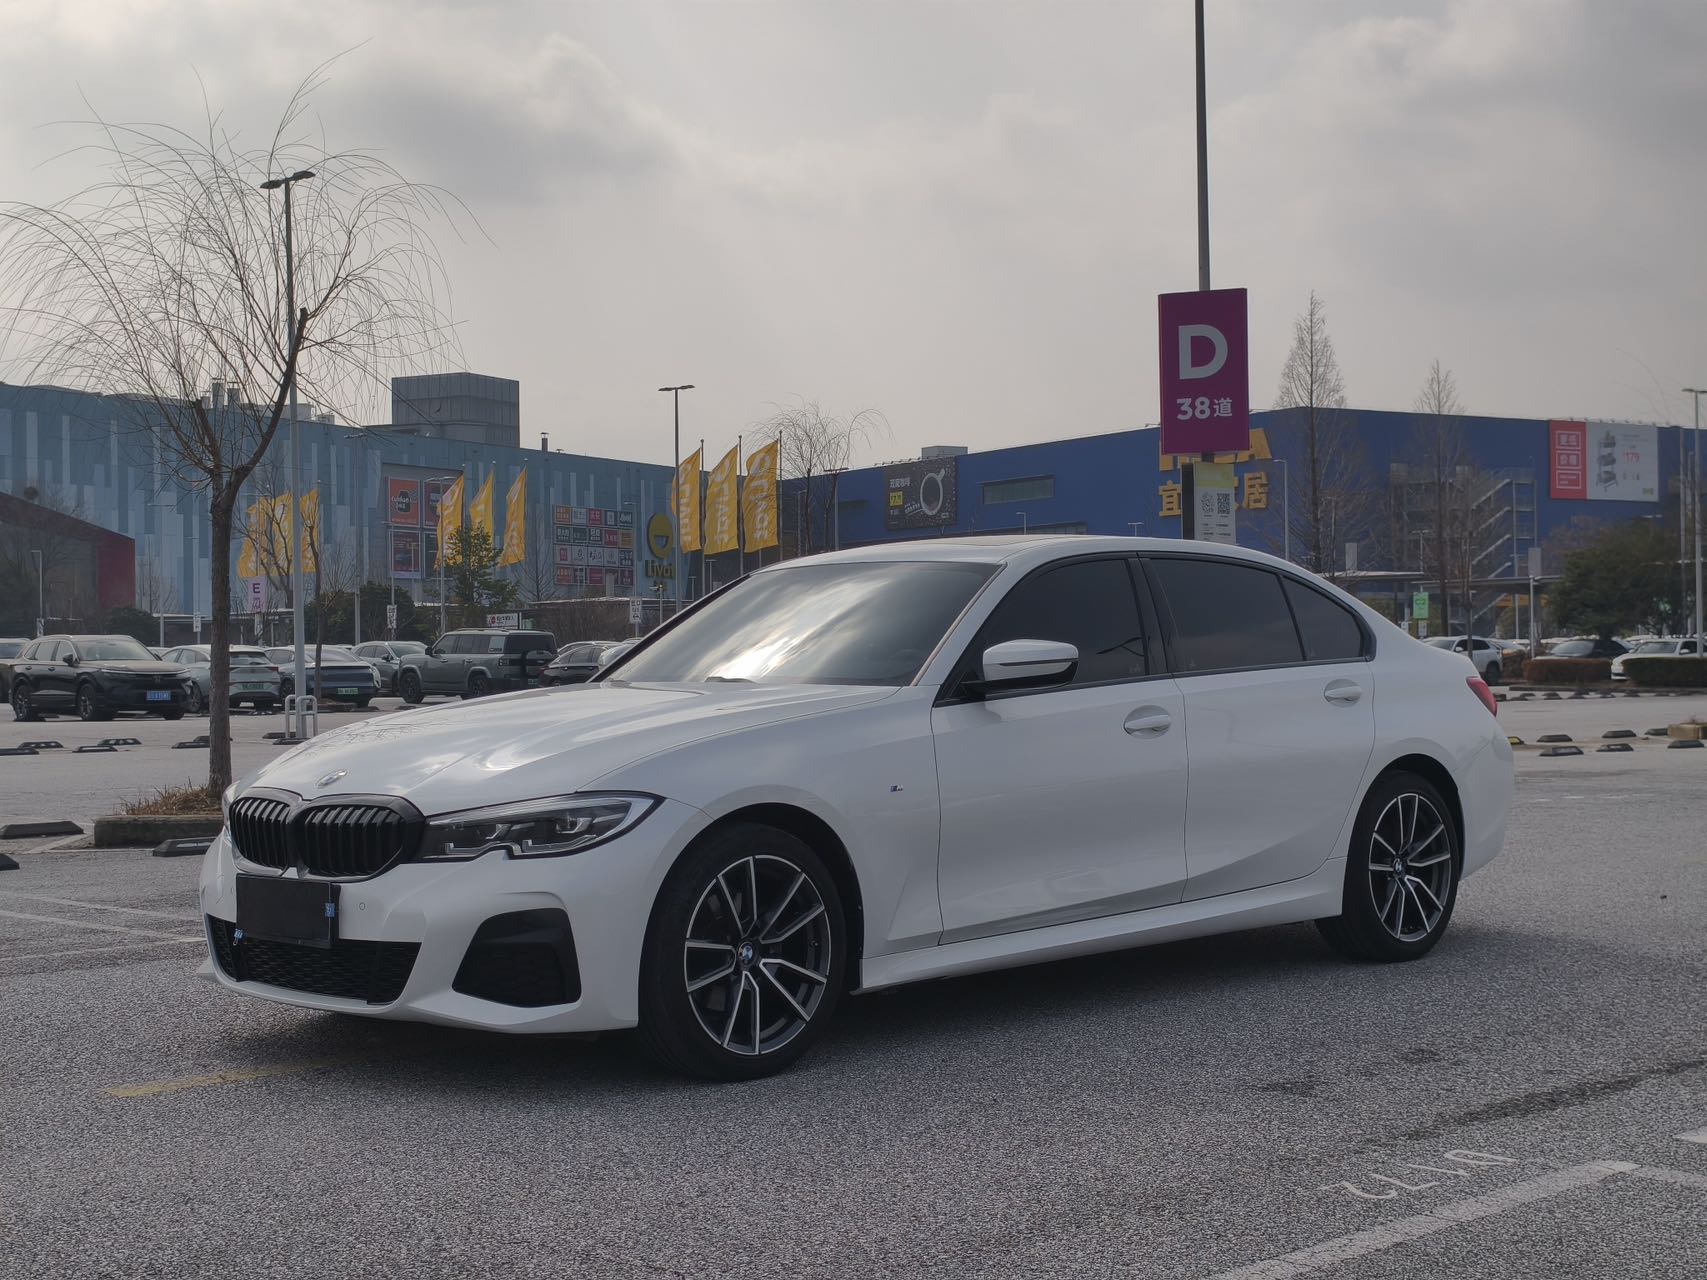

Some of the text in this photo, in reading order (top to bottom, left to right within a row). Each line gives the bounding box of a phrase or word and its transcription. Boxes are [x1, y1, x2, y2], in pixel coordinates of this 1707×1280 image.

[1178, 324, 1228, 380] D
[1176, 396, 1233, 420] 38道
[252, 582, 261, 594] E
